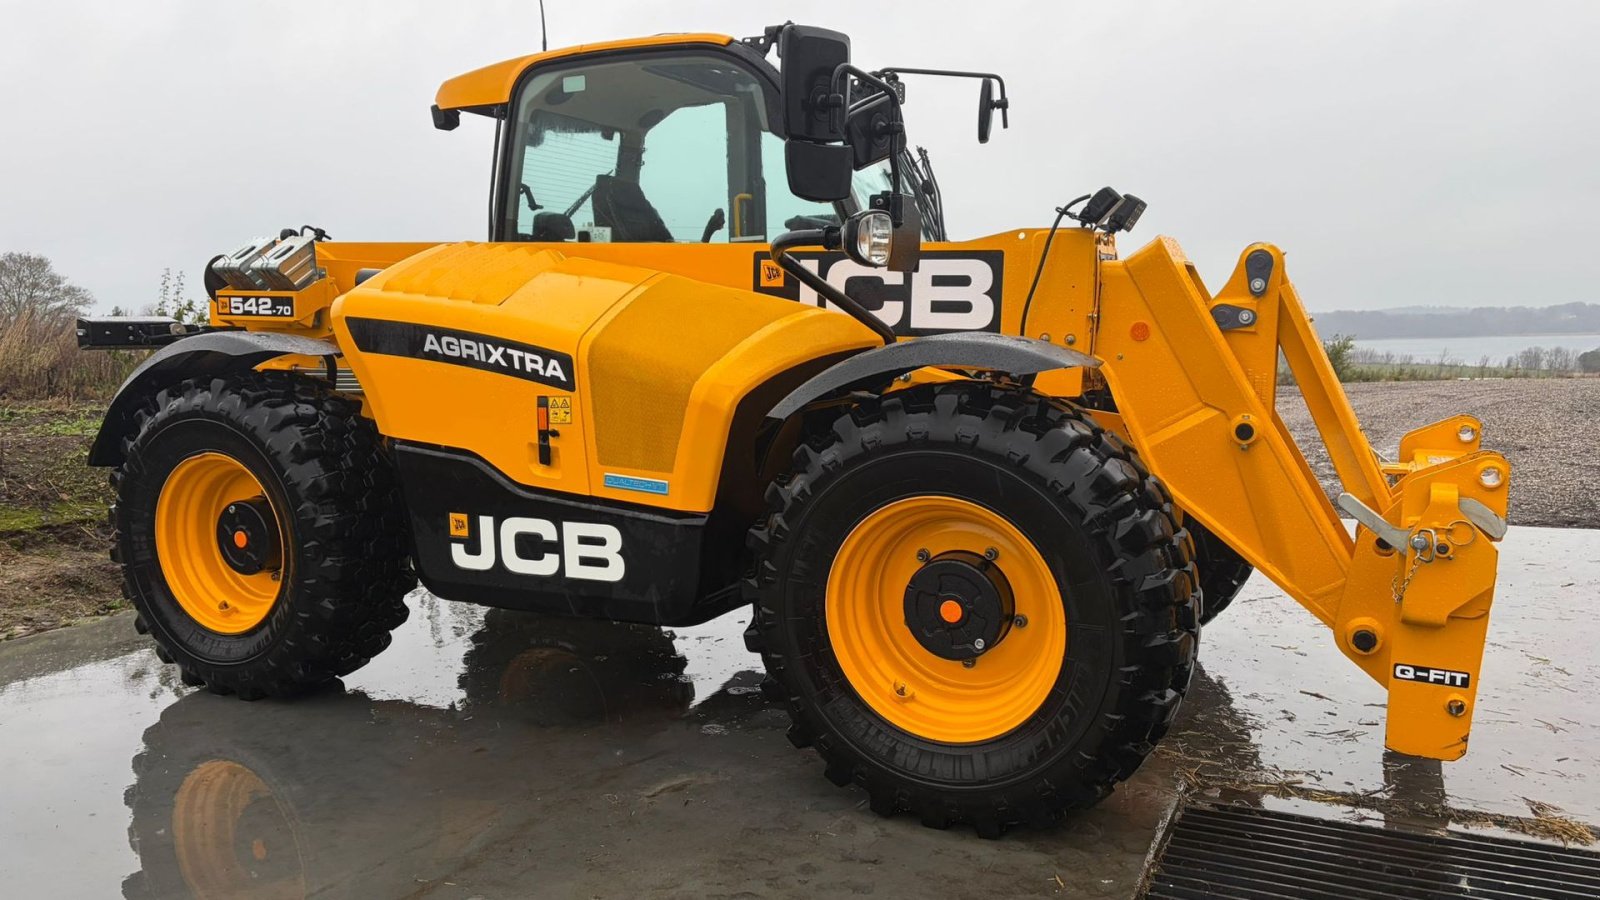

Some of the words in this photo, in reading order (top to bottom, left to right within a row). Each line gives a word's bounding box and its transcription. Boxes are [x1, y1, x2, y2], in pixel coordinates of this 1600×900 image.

[424, 333, 567, 382] AGRIXTRA
[451, 515, 625, 582] JCB
[1395, 664, 1468, 686] Q-FIT
